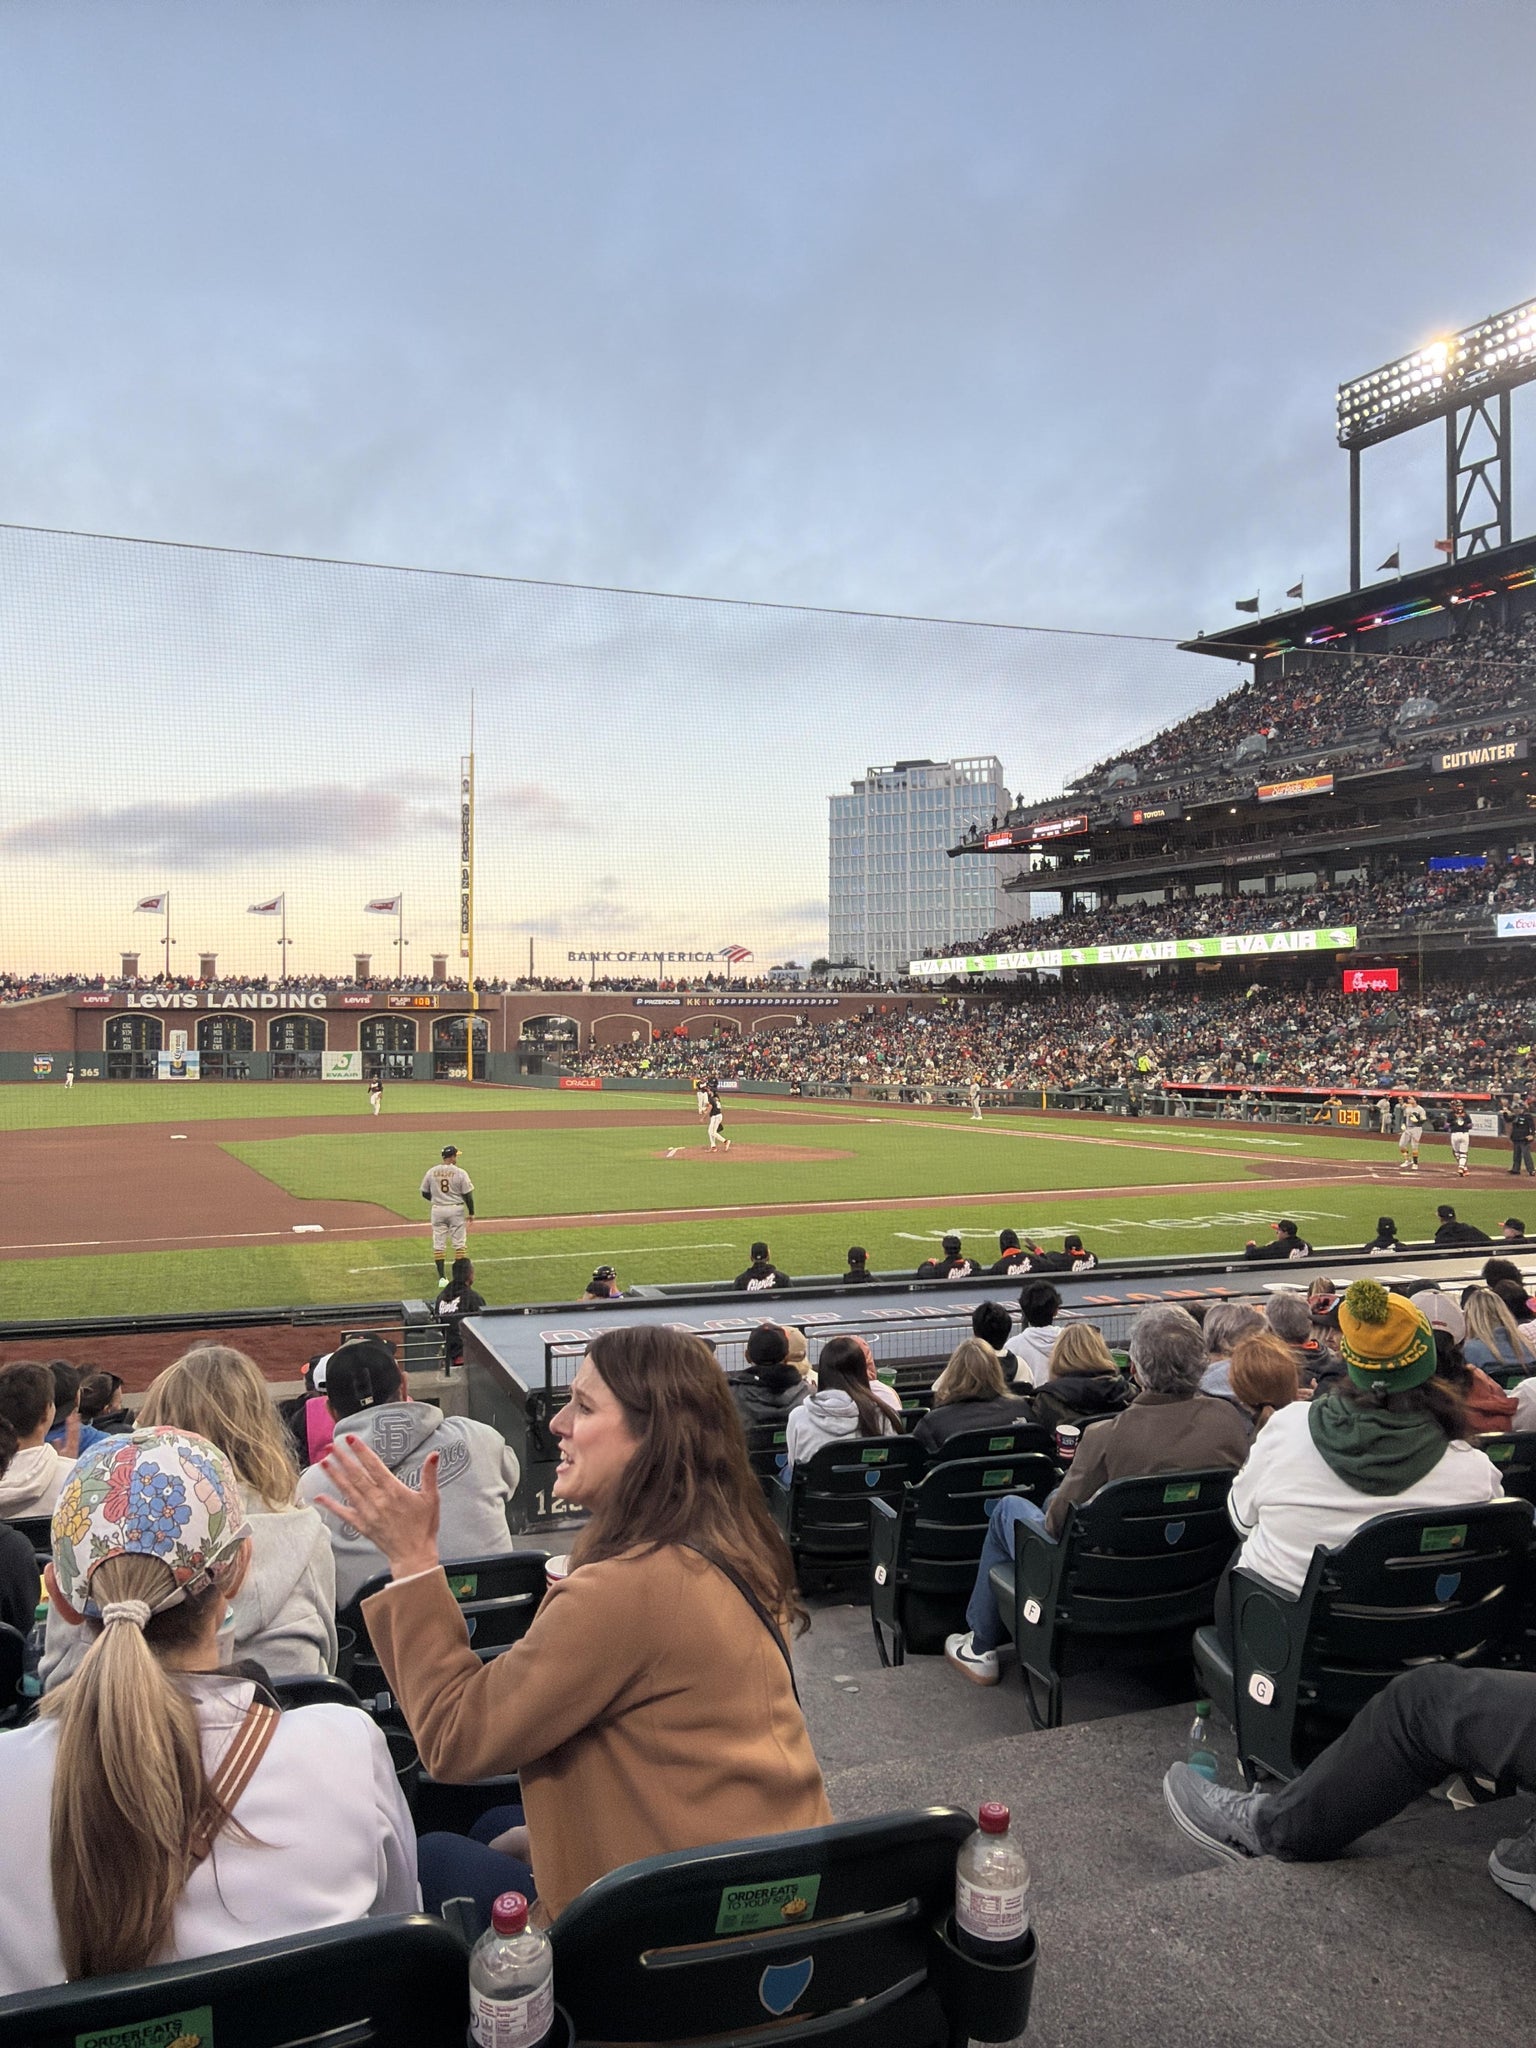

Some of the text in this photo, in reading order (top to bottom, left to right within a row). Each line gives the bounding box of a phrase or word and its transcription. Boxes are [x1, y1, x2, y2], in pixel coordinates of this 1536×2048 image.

[1442, 743, 1516, 769] CUTWATER
[1143, 809, 1166, 819] TOYOTA
[461, 893, 471, 934] FARE
[568, 951, 715, 962] BANK OF AMERICA
[207, 992, 327, 1009] LANDING
[80, 1069, 100, 1077] 365
[448, 1069, 468, 1078] 309
[565, 1079, 596, 1087] ORACLE
[440, 1179, 449, 1193] 8
[1066, 1208, 1348, 1234] Health
[877, 1569, 884, 1582] E
[1029, 1605, 1036, 1617] F
[1256, 1682, 1266, 1697] G
[727, 1883, 799, 1902] ORDER EATS
[727, 1901, 741, 1911] TO
[742, 1897, 771, 1909] YOUR
[142, 2018, 183, 2038] EATS
